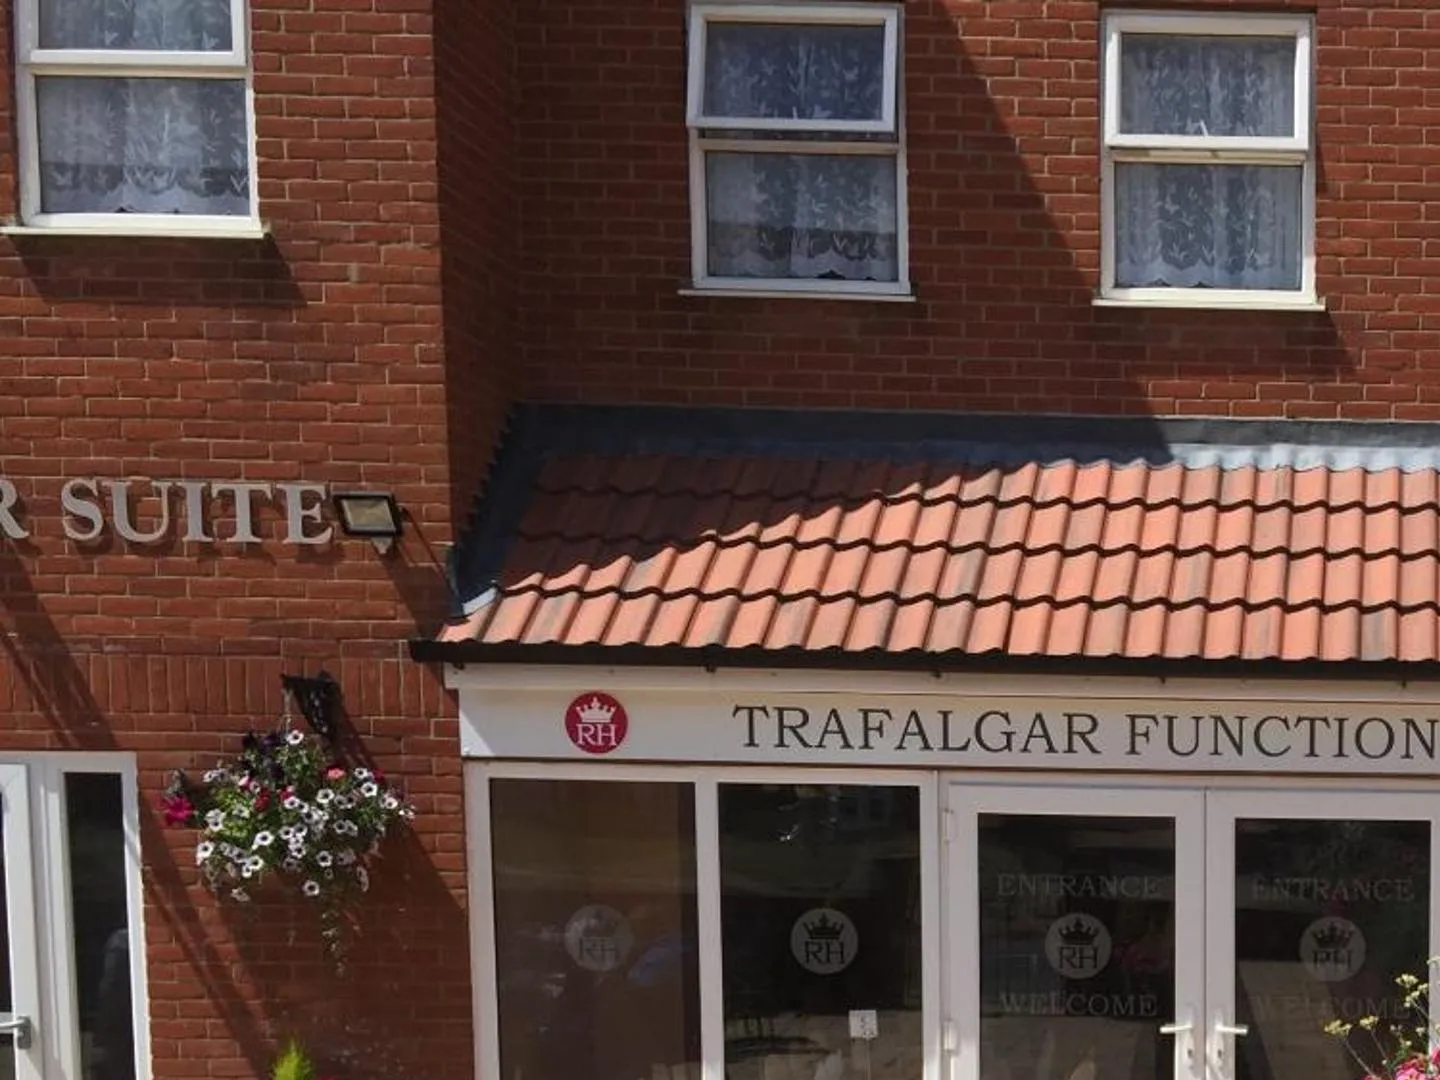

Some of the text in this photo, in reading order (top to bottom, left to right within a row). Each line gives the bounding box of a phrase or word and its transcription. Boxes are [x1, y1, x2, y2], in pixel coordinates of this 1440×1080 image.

[62, 478, 332, 544] SUITE
[576, 723, 617, 746] RH
[732, 704, 1102, 754] TRAFALGAR
[1125, 714, 1440, 760] FUNCTION
[998, 873, 1161, 898] ENTRANCE
[1252, 876, 1414, 901] ENTRANCE
[805, 941, 845, 964] RH
[1059, 946, 1098, 969] RH
[1000, 992, 1158, 1017] WELCOME
